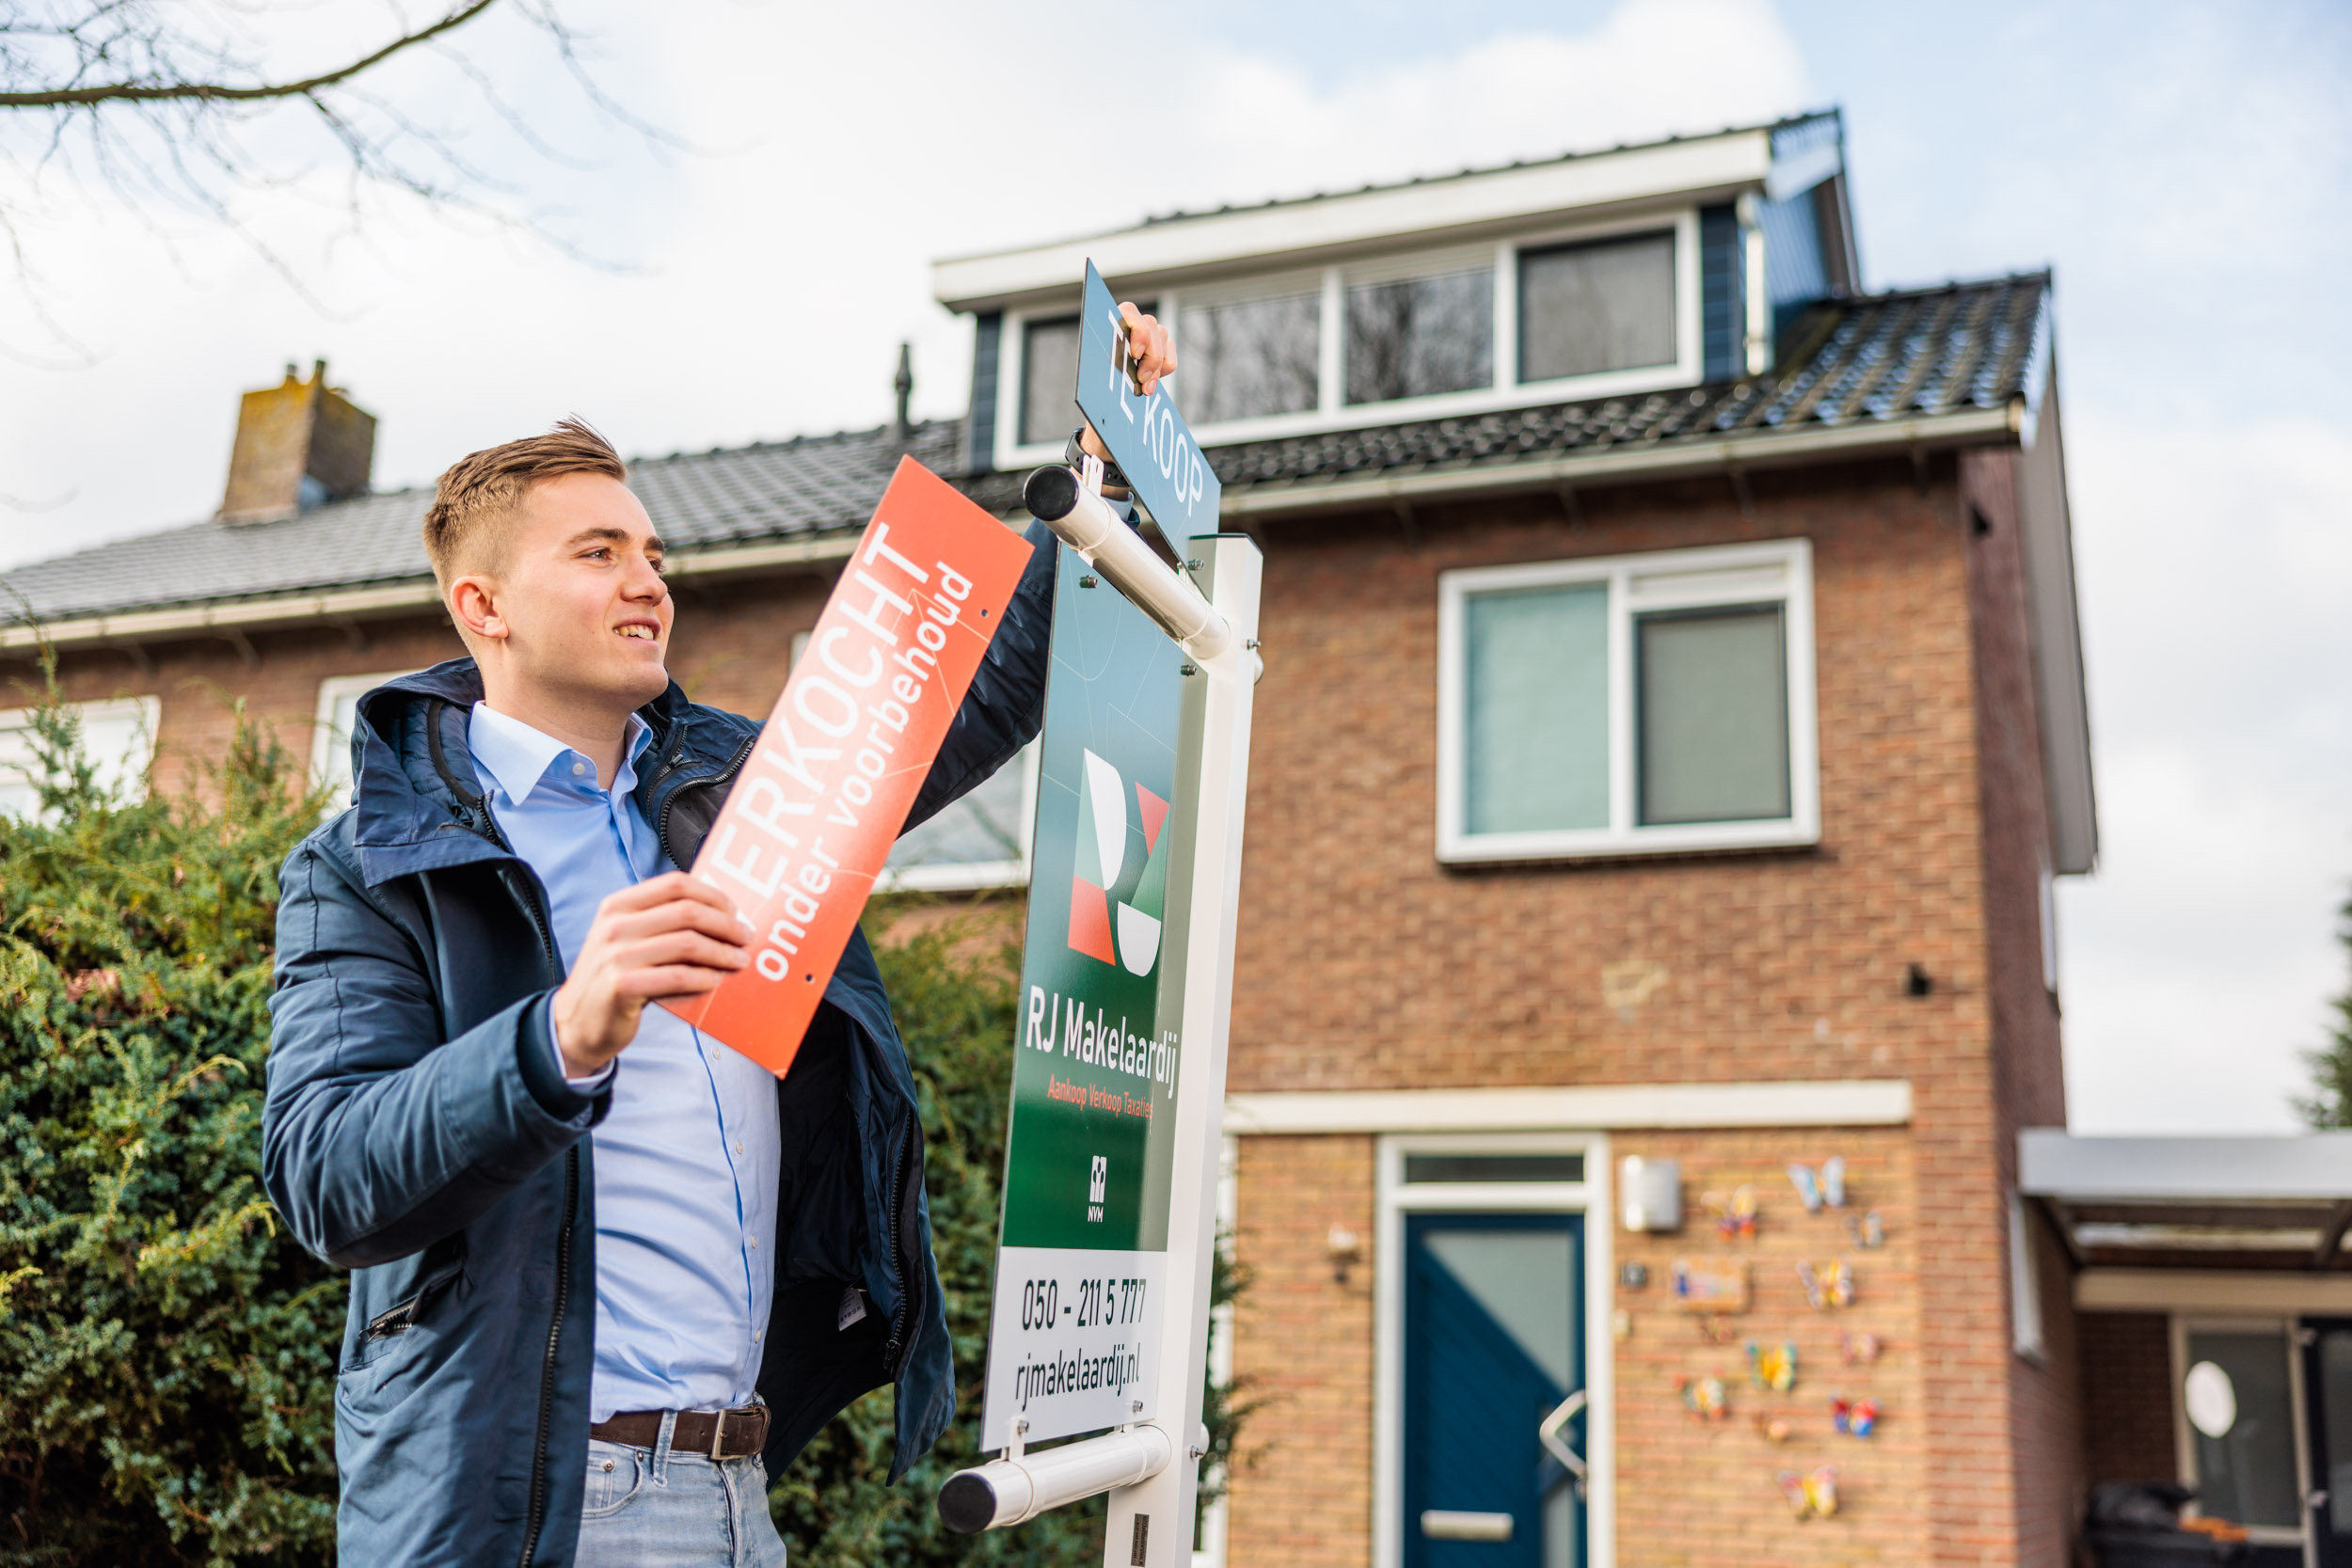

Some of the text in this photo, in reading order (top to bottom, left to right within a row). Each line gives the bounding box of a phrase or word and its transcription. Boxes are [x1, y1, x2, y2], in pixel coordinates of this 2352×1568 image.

[1108, 309, 1202, 517] TE KOOP
[700, 522, 930, 932] ERKOCHT
[755, 561, 973, 981] onder voorbehoud
[1025, 985, 1177, 1099] RJ Makelaardij
[1047, 1073, 1152, 1119] Aankoop Verkoop Taxaties
[1088, 1206, 1104, 1223] NVM
[1023, 1278, 1057, 1331] 050
[1077, 1279, 1101, 1327] 211
[1105, 1279, 1116, 1324] 5
[1120, 1278, 1147, 1324] 777
[1015, 1341, 1140, 1412] rjmakelaardij.nl
